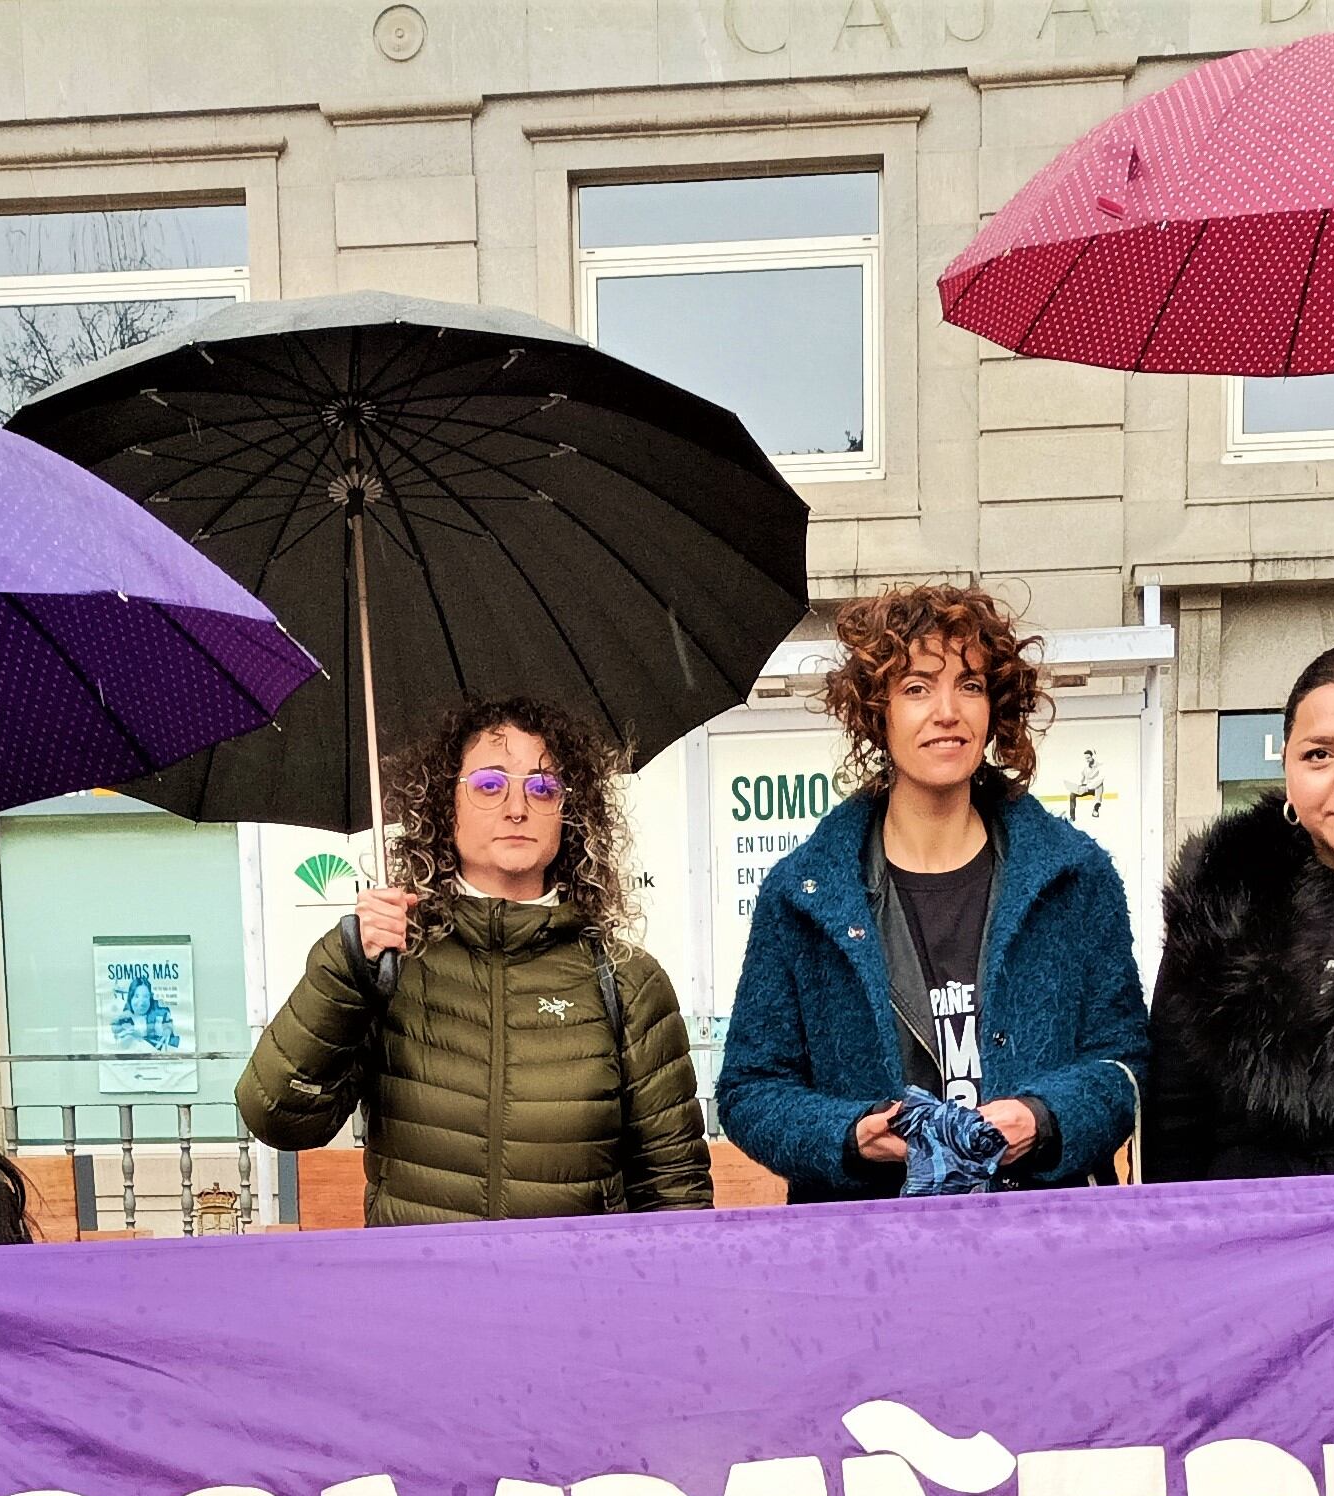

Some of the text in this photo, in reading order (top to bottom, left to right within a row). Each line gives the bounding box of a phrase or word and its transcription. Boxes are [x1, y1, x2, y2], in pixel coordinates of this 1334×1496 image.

[737, 836, 754, 854] EN
[758, 835, 774, 853] TU
[737, 868, 755, 885] EN
[107, 959, 179, 981] SOMOS MÁS
